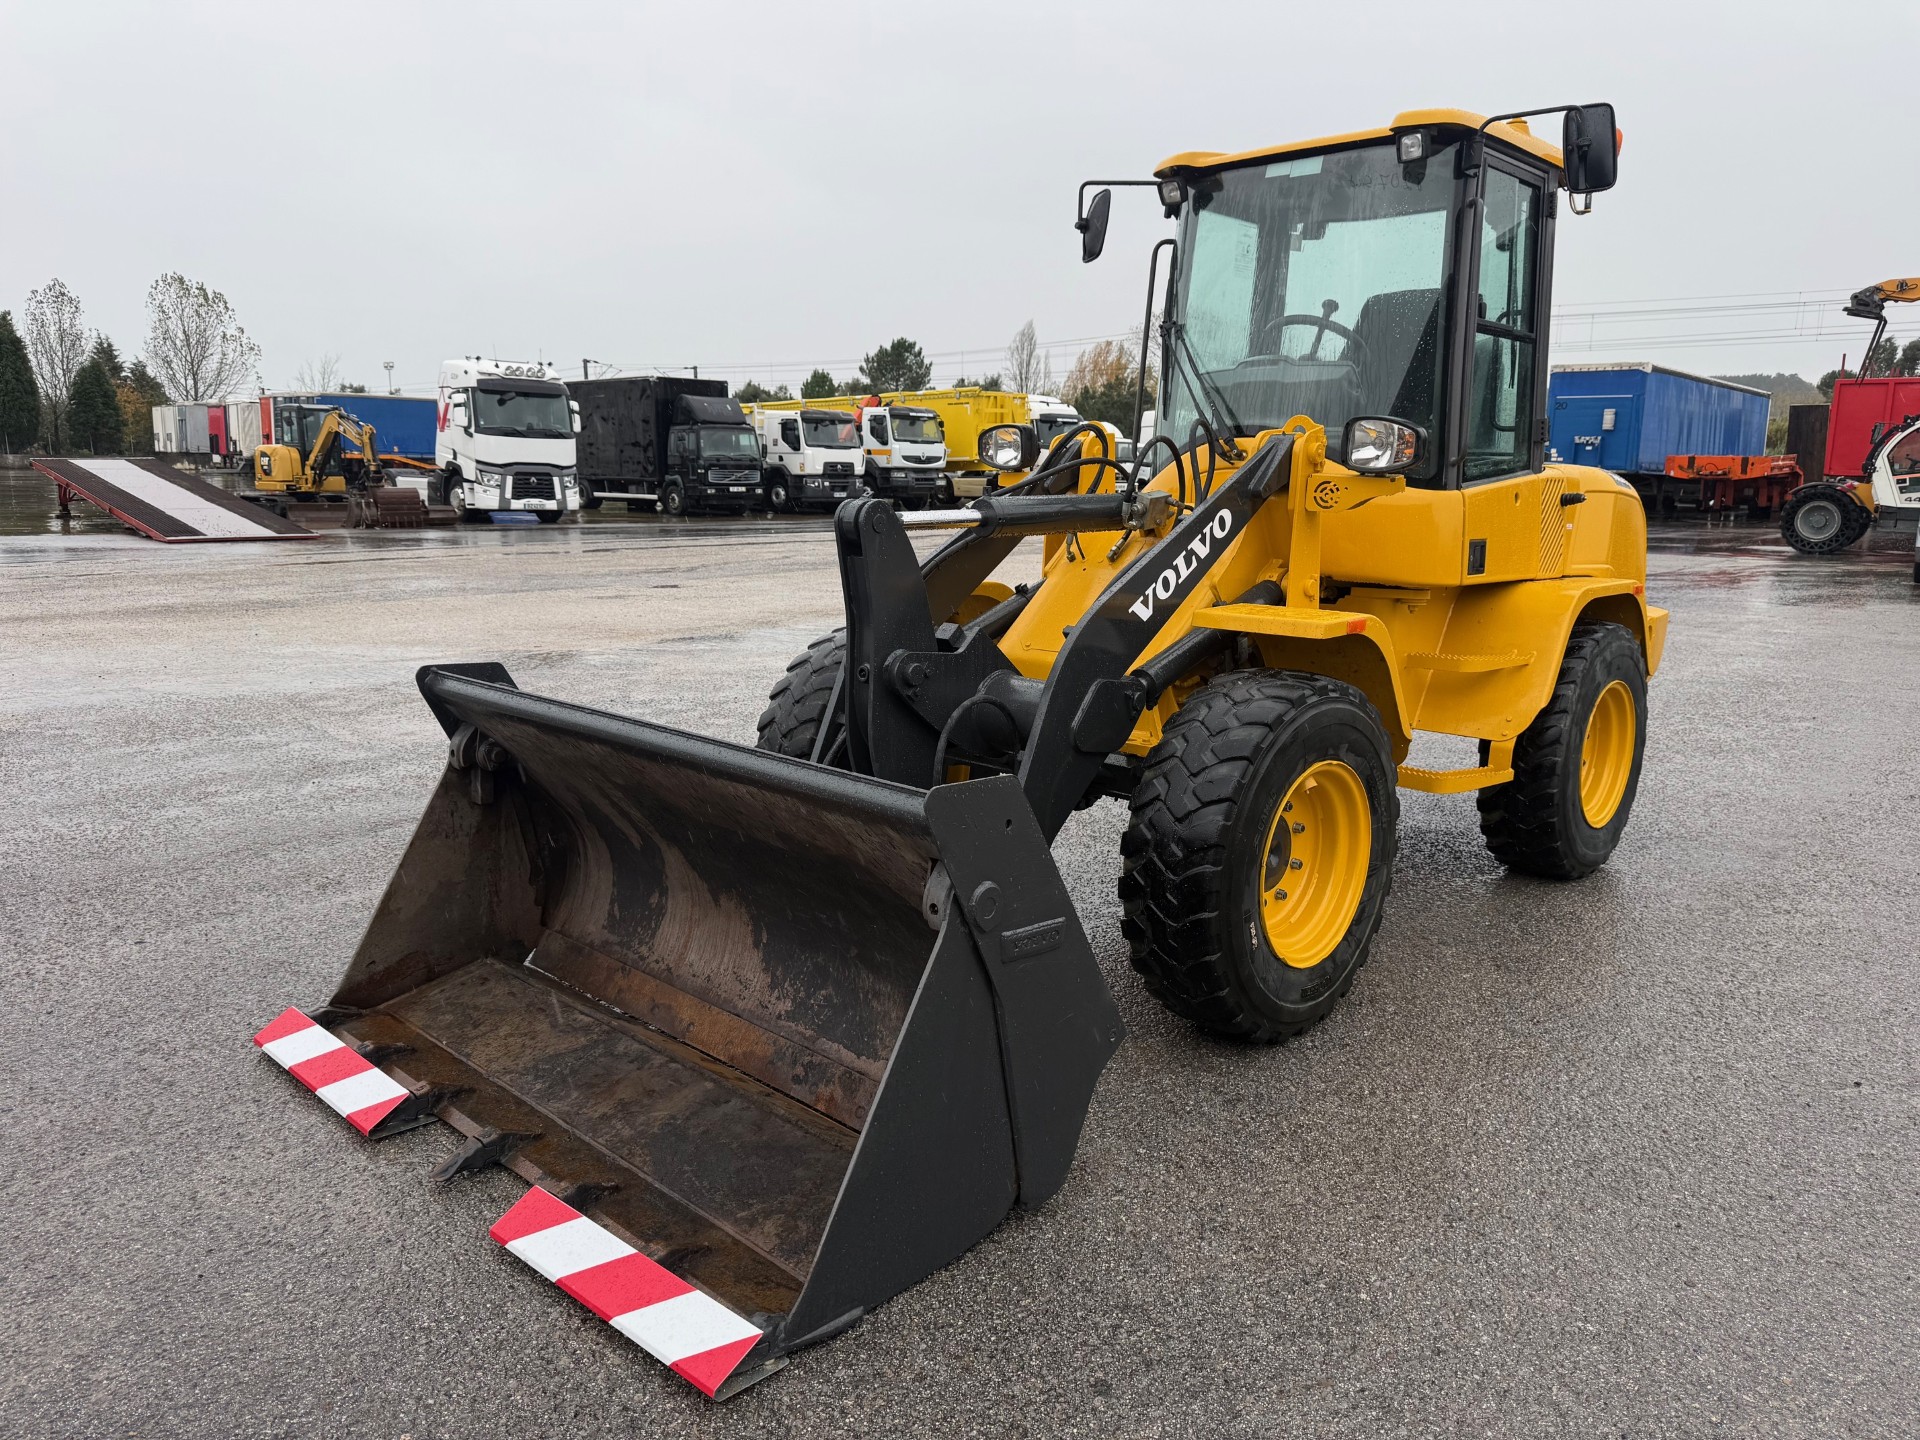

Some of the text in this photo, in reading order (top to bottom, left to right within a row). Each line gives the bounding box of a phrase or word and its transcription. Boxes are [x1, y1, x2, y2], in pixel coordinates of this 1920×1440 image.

[1555, 401, 1568, 411] 20
[261, 457, 270, 465] CAT
[1128, 508, 1233, 622] VOLVO
